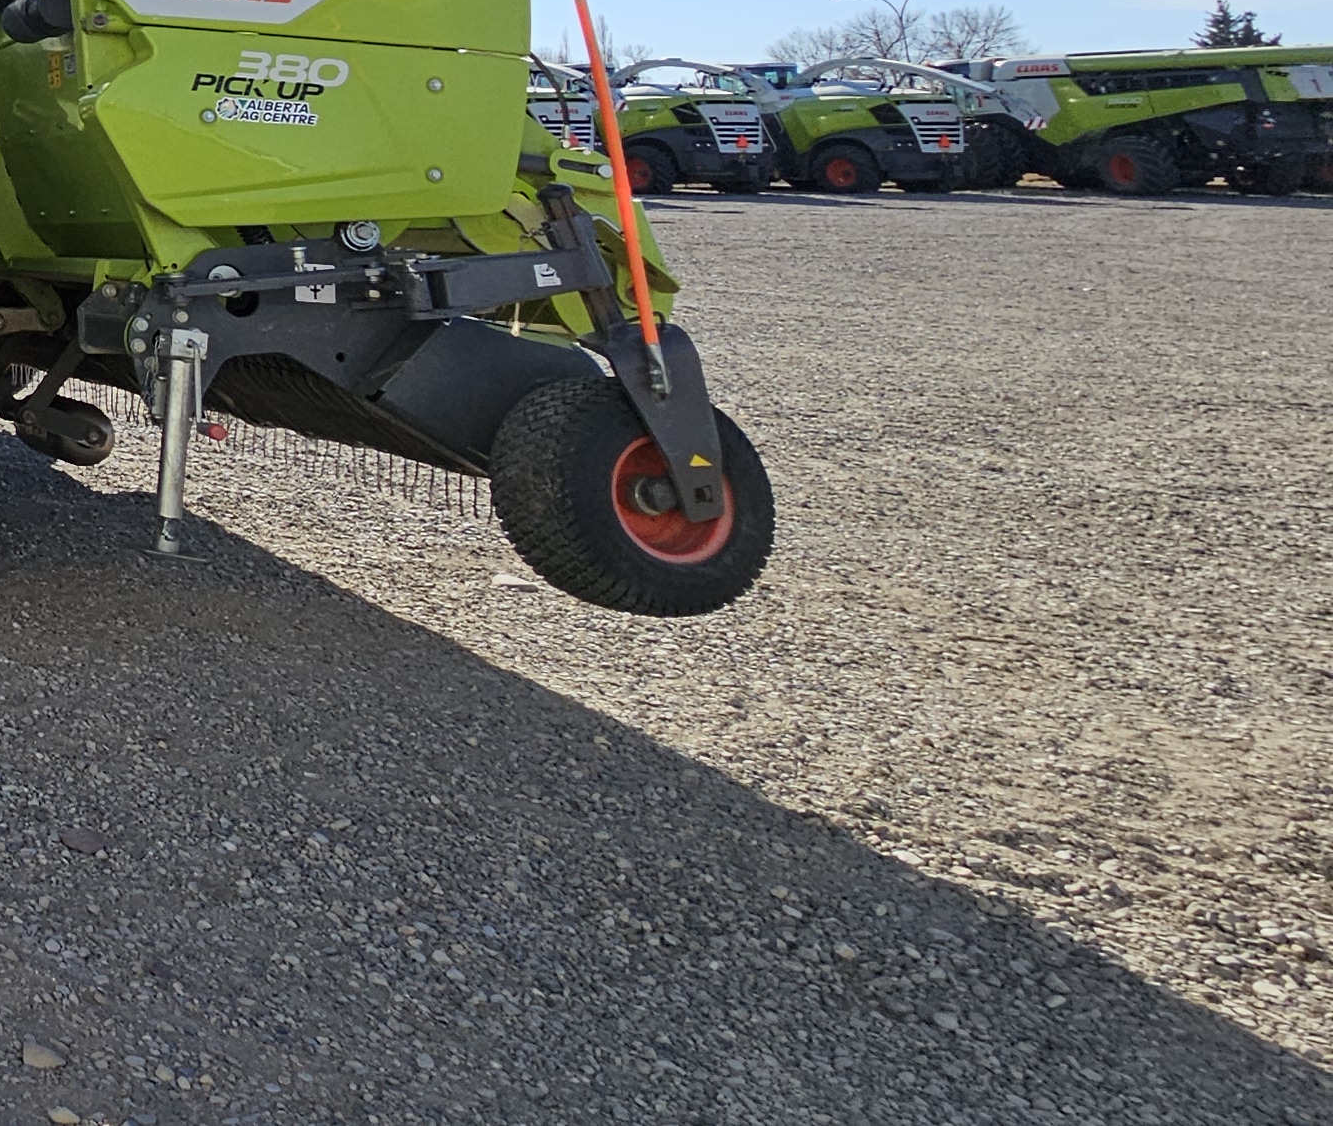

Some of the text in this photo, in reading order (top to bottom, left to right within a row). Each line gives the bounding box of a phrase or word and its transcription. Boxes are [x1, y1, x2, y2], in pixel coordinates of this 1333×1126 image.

[234, 50, 349, 87] 380
[245, 99, 309, 114] ALBERTA
[239, 111, 317, 125] AG CENTRE
